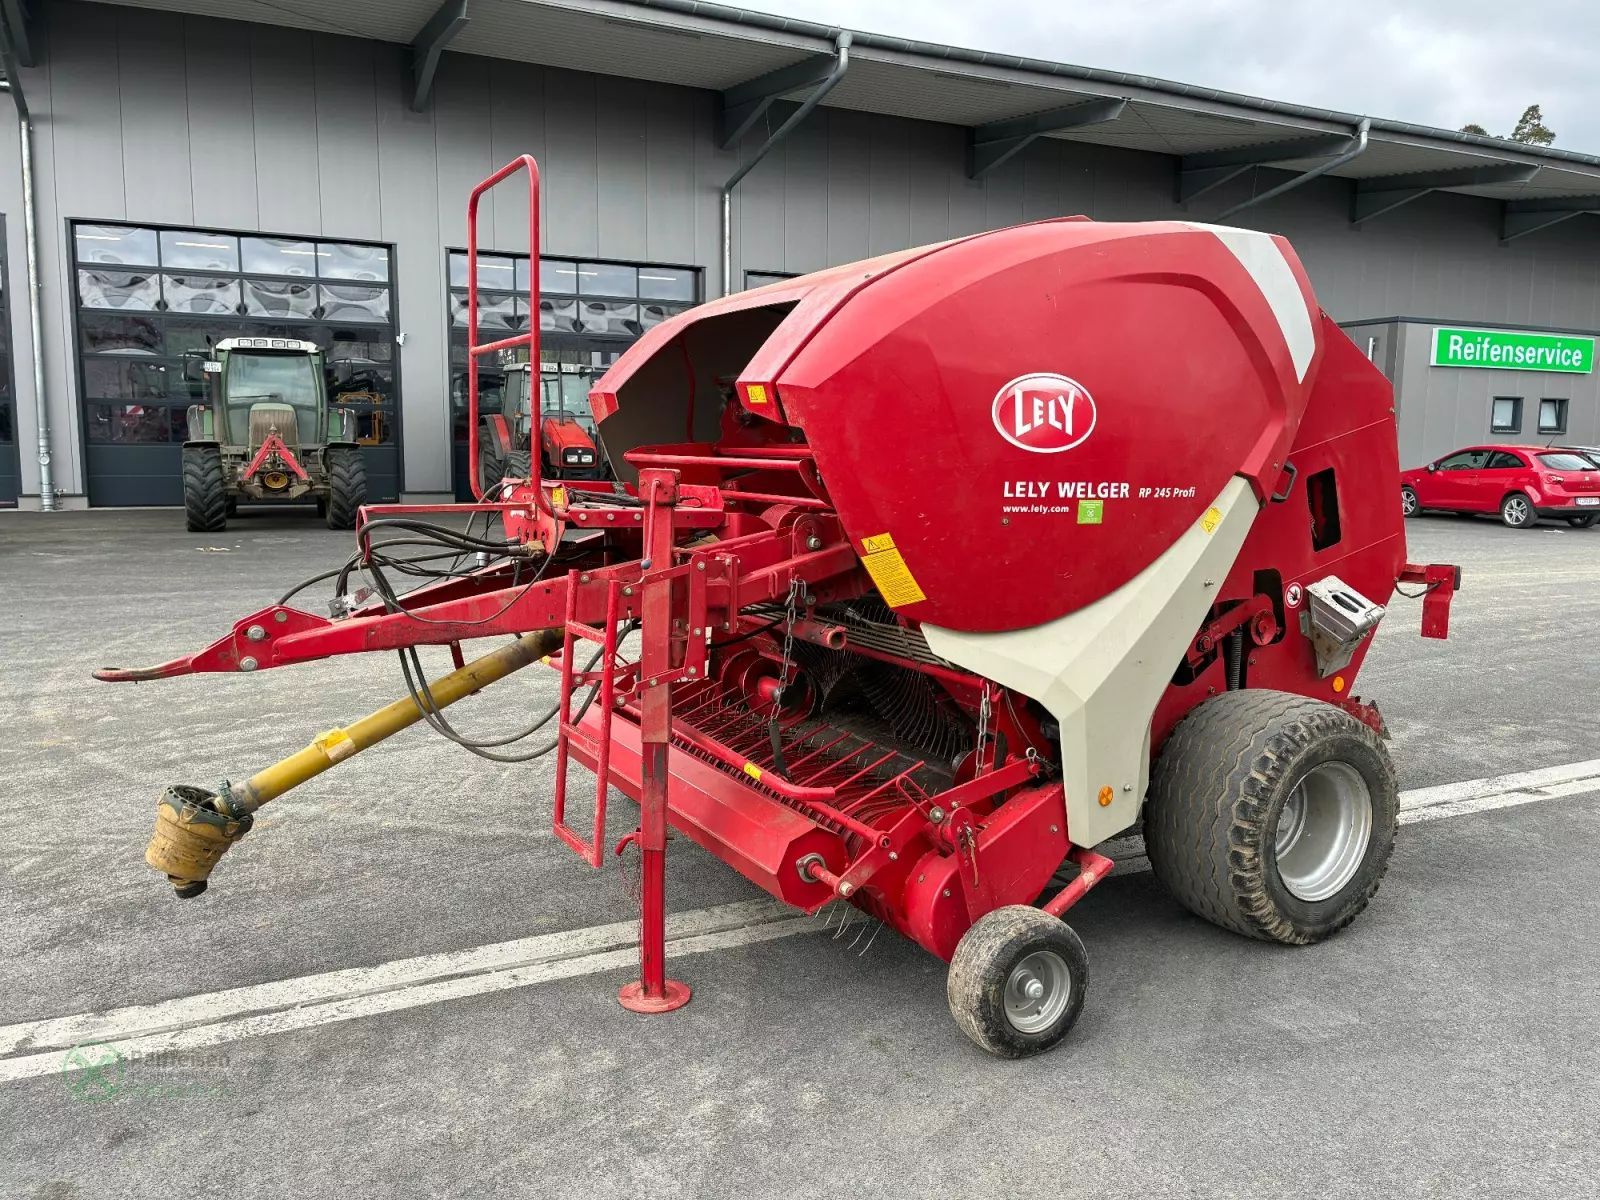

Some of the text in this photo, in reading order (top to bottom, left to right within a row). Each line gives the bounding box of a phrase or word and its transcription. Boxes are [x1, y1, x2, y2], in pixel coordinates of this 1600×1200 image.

[1448, 334, 1583, 367] Reifenservice
[1013, 387, 1076, 438] LELY
[1003, 481, 1196, 499] LELY WELGER RP 245 Profi
[1002, 503, 1070, 514] www.lely.com
